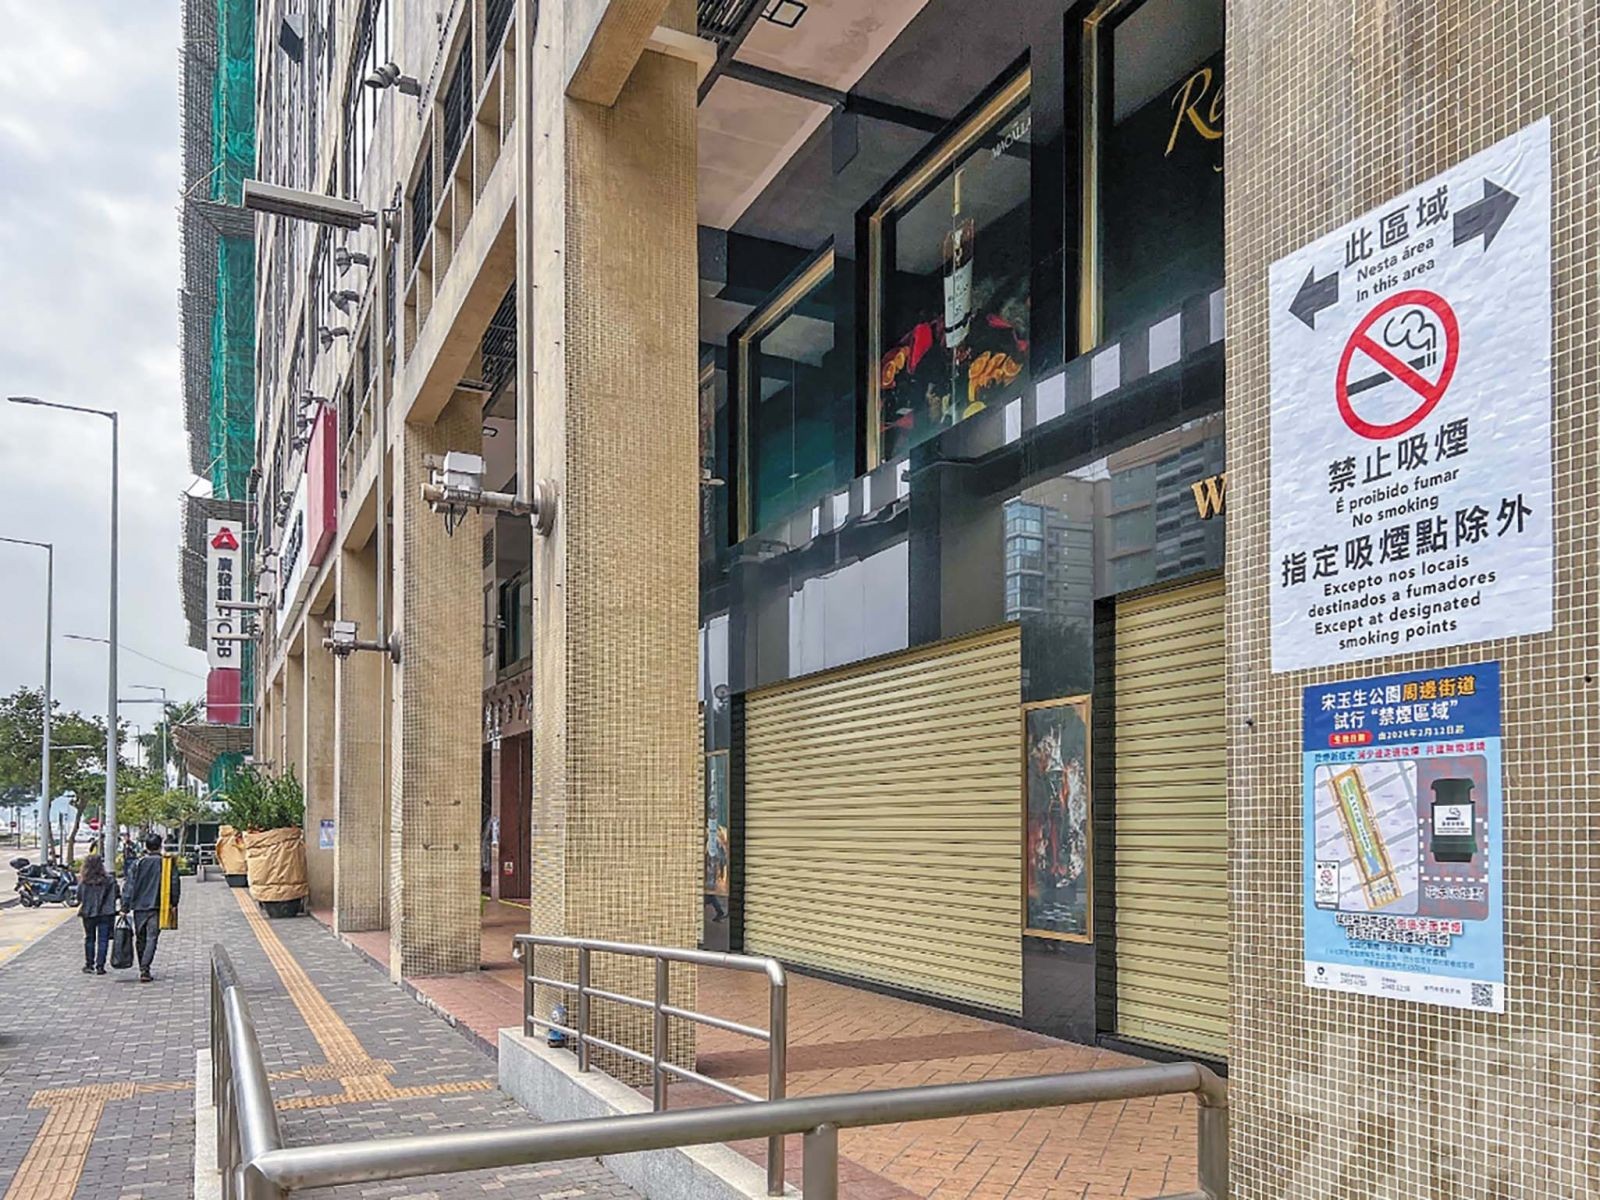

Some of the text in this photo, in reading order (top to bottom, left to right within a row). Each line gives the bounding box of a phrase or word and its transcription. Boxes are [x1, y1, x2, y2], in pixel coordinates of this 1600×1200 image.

[1164, 68, 1224, 172] Re
[1344, 184, 1449, 268] 此區域
[1356, 236, 1434, 282] Nesta área
[1356, 257, 1435, 302] In this area
[1328, 417, 1469, 494] 禁止吸煙
[1336, 467, 1460, 516] É proibido fumar
[1352, 494, 1439, 527] No smoking
[1281, 493, 1533, 588] 指定吸煙點除外
[1308, 569, 1496, 618] destinados a fumadores
[1324, 554, 1469, 597] Excepto nos locais
[1315, 591, 1481, 635] Except at designated
[1338, 618, 1458, 650] smoking points
[1321, 675, 1476, 711] 宋玉生公園周邊街道
